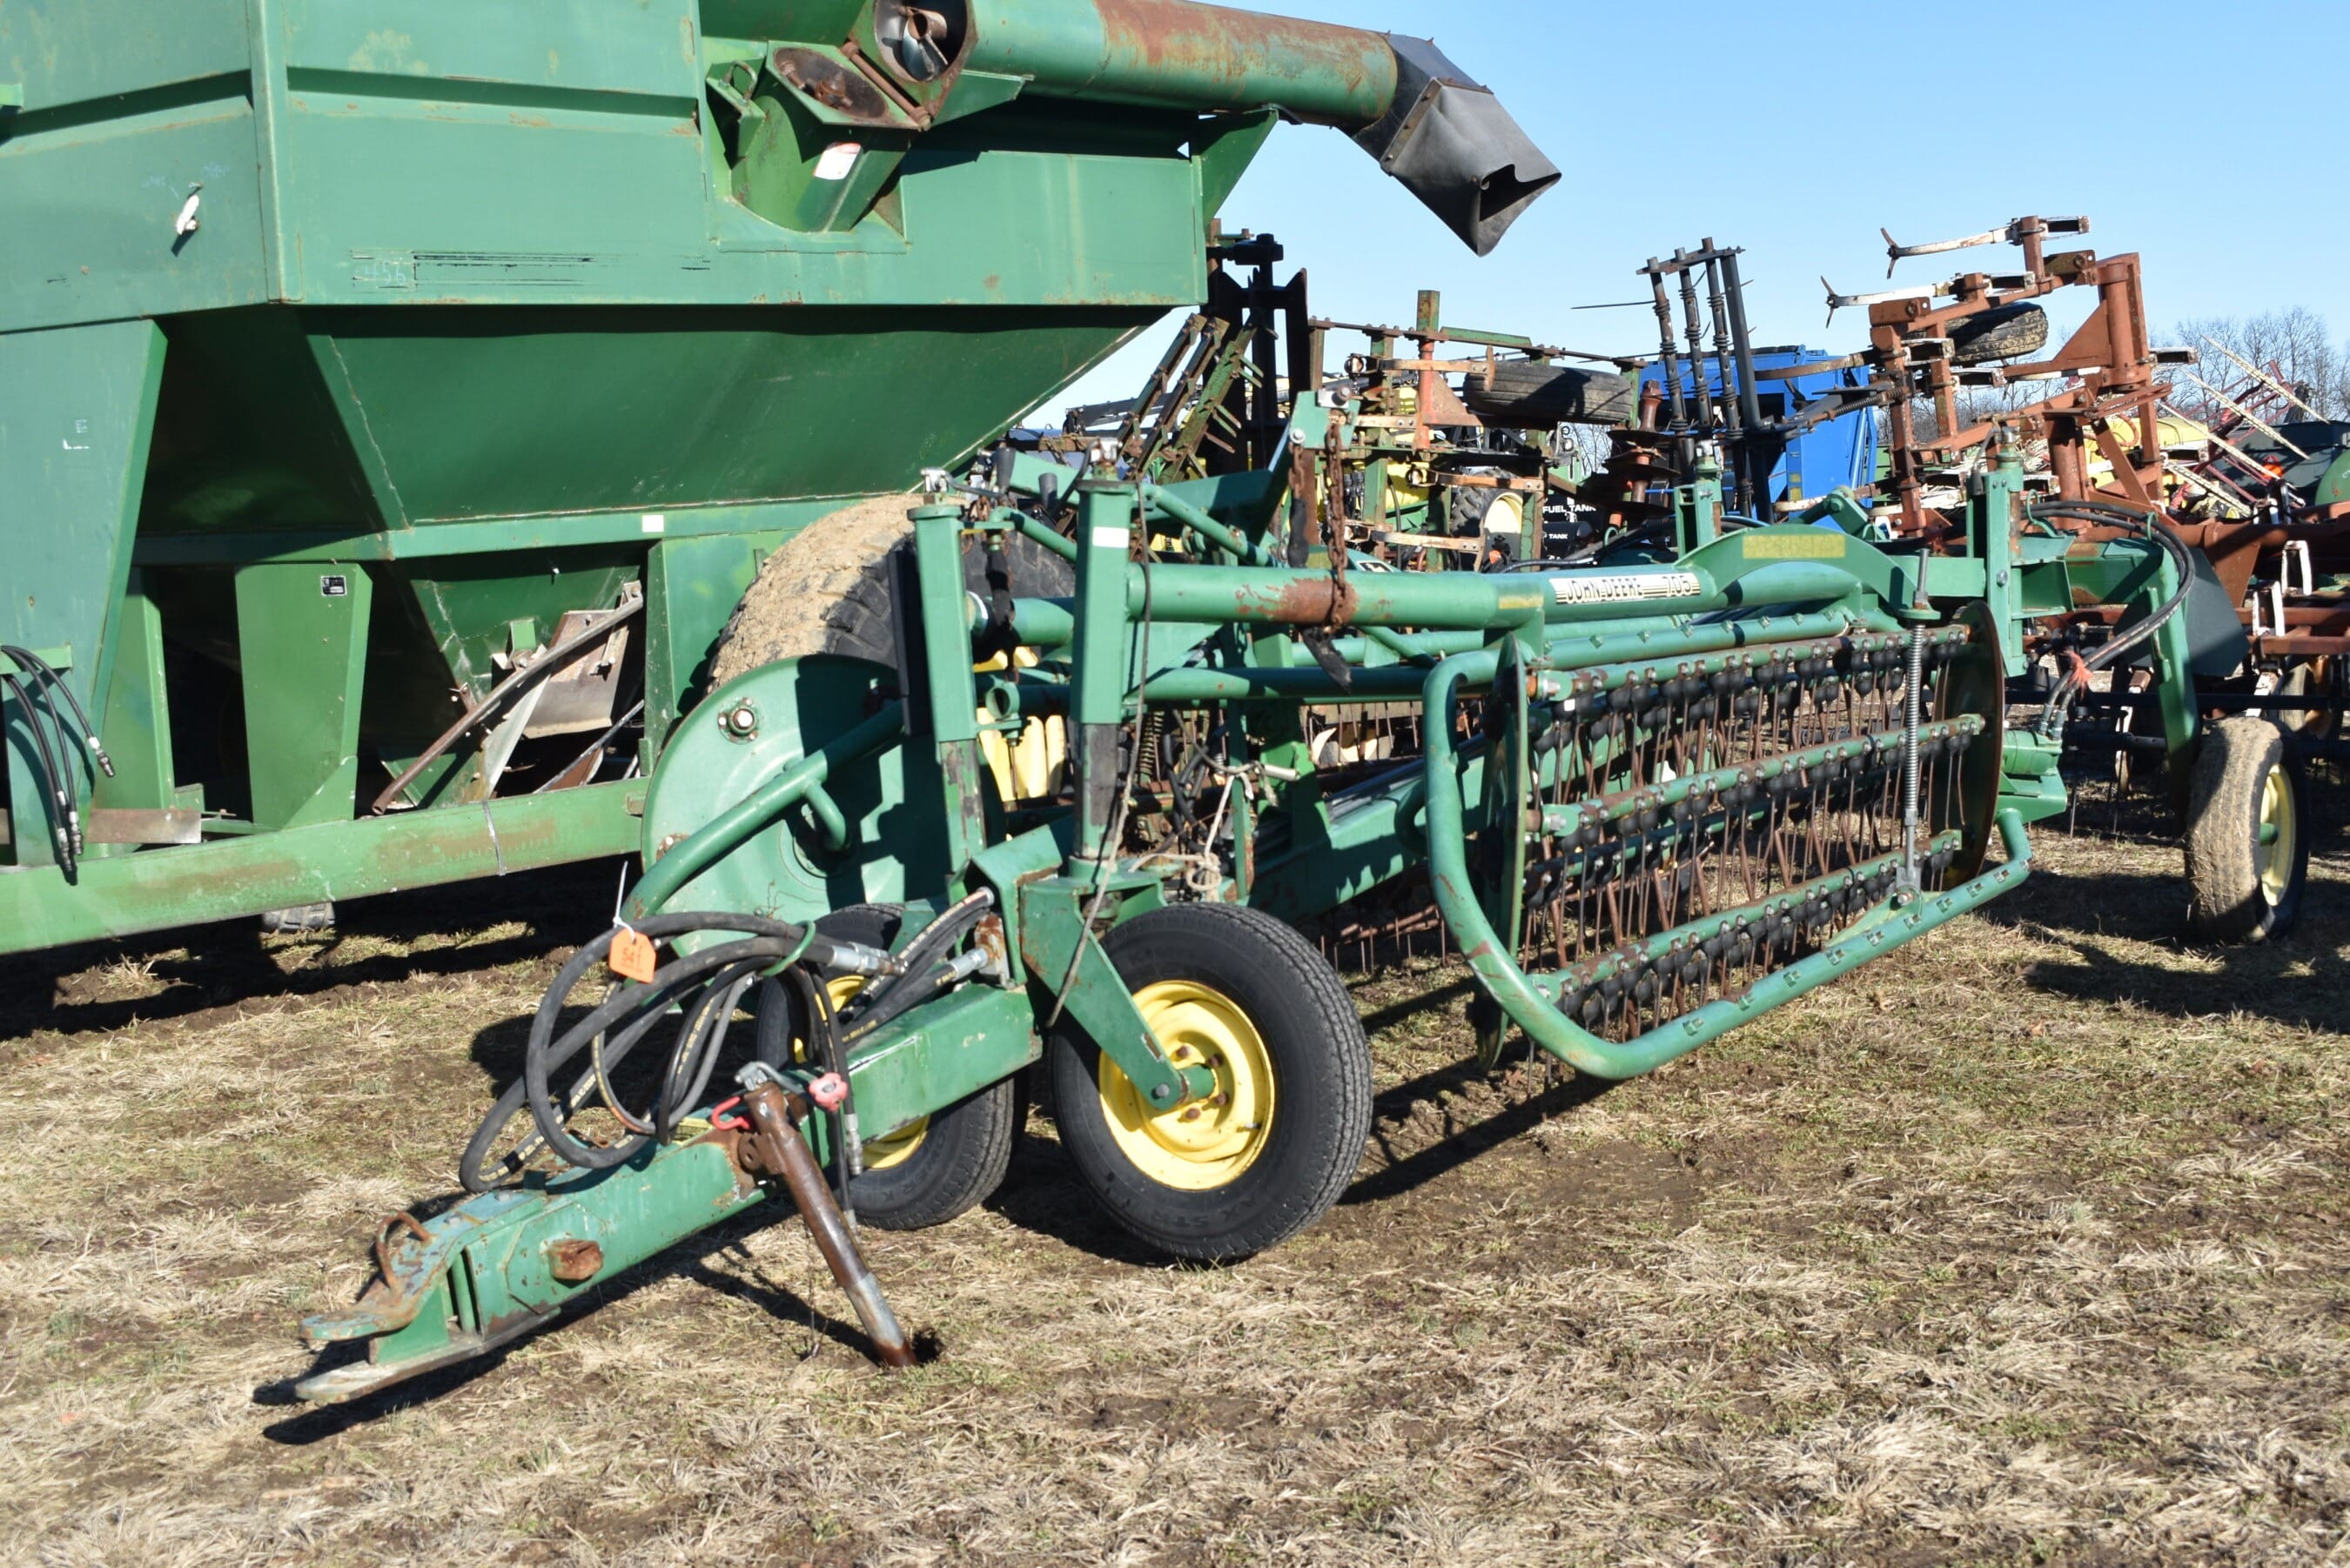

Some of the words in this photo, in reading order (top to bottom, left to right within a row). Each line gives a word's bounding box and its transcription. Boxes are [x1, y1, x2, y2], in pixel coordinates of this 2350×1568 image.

[1542, 505, 1567, 513] FUEL
[1567, 579, 1601, 603] JOHN
[1602, 577, 1643, 600] DEERE
[1662, 574, 1693, 595] 705
